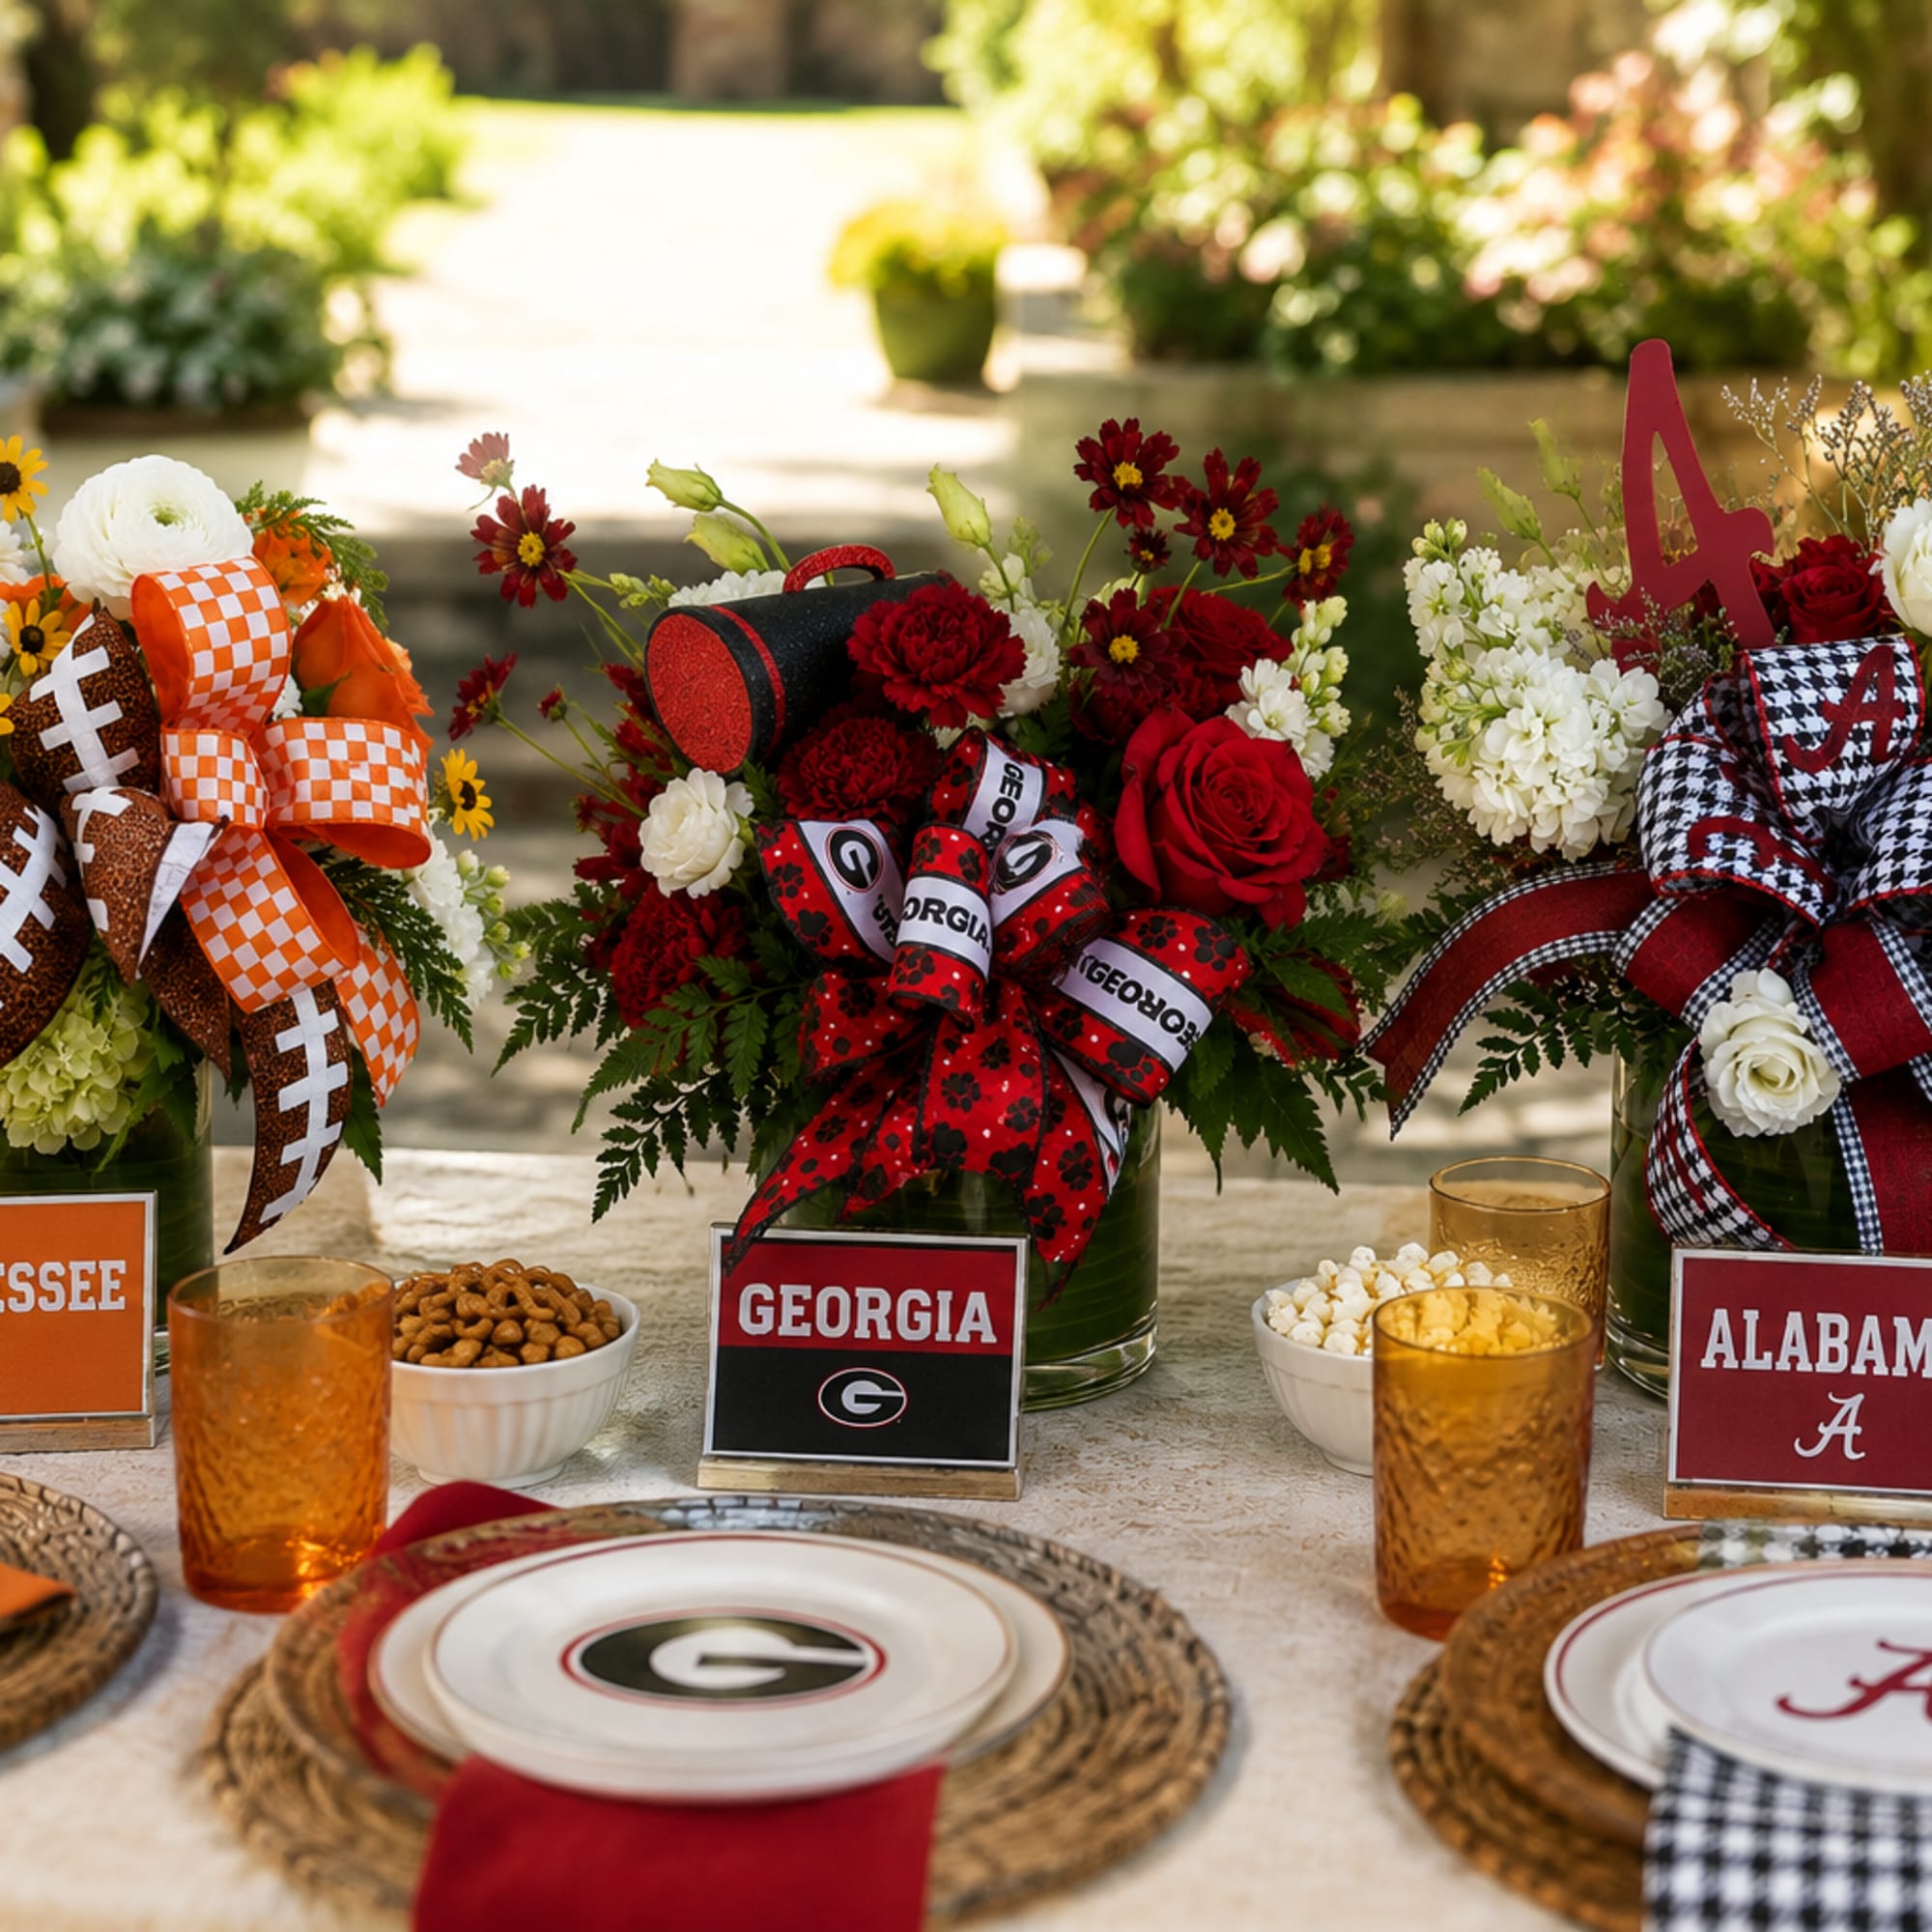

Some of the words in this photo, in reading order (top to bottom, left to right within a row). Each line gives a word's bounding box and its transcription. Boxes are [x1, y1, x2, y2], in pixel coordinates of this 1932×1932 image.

[0, 1260, 126, 1313] SSEE
[738, 1284, 997, 1344] GEORGIA
[1700, 1308, 1932, 1378] ALABAM
[1794, 1392, 1865, 1460] A
